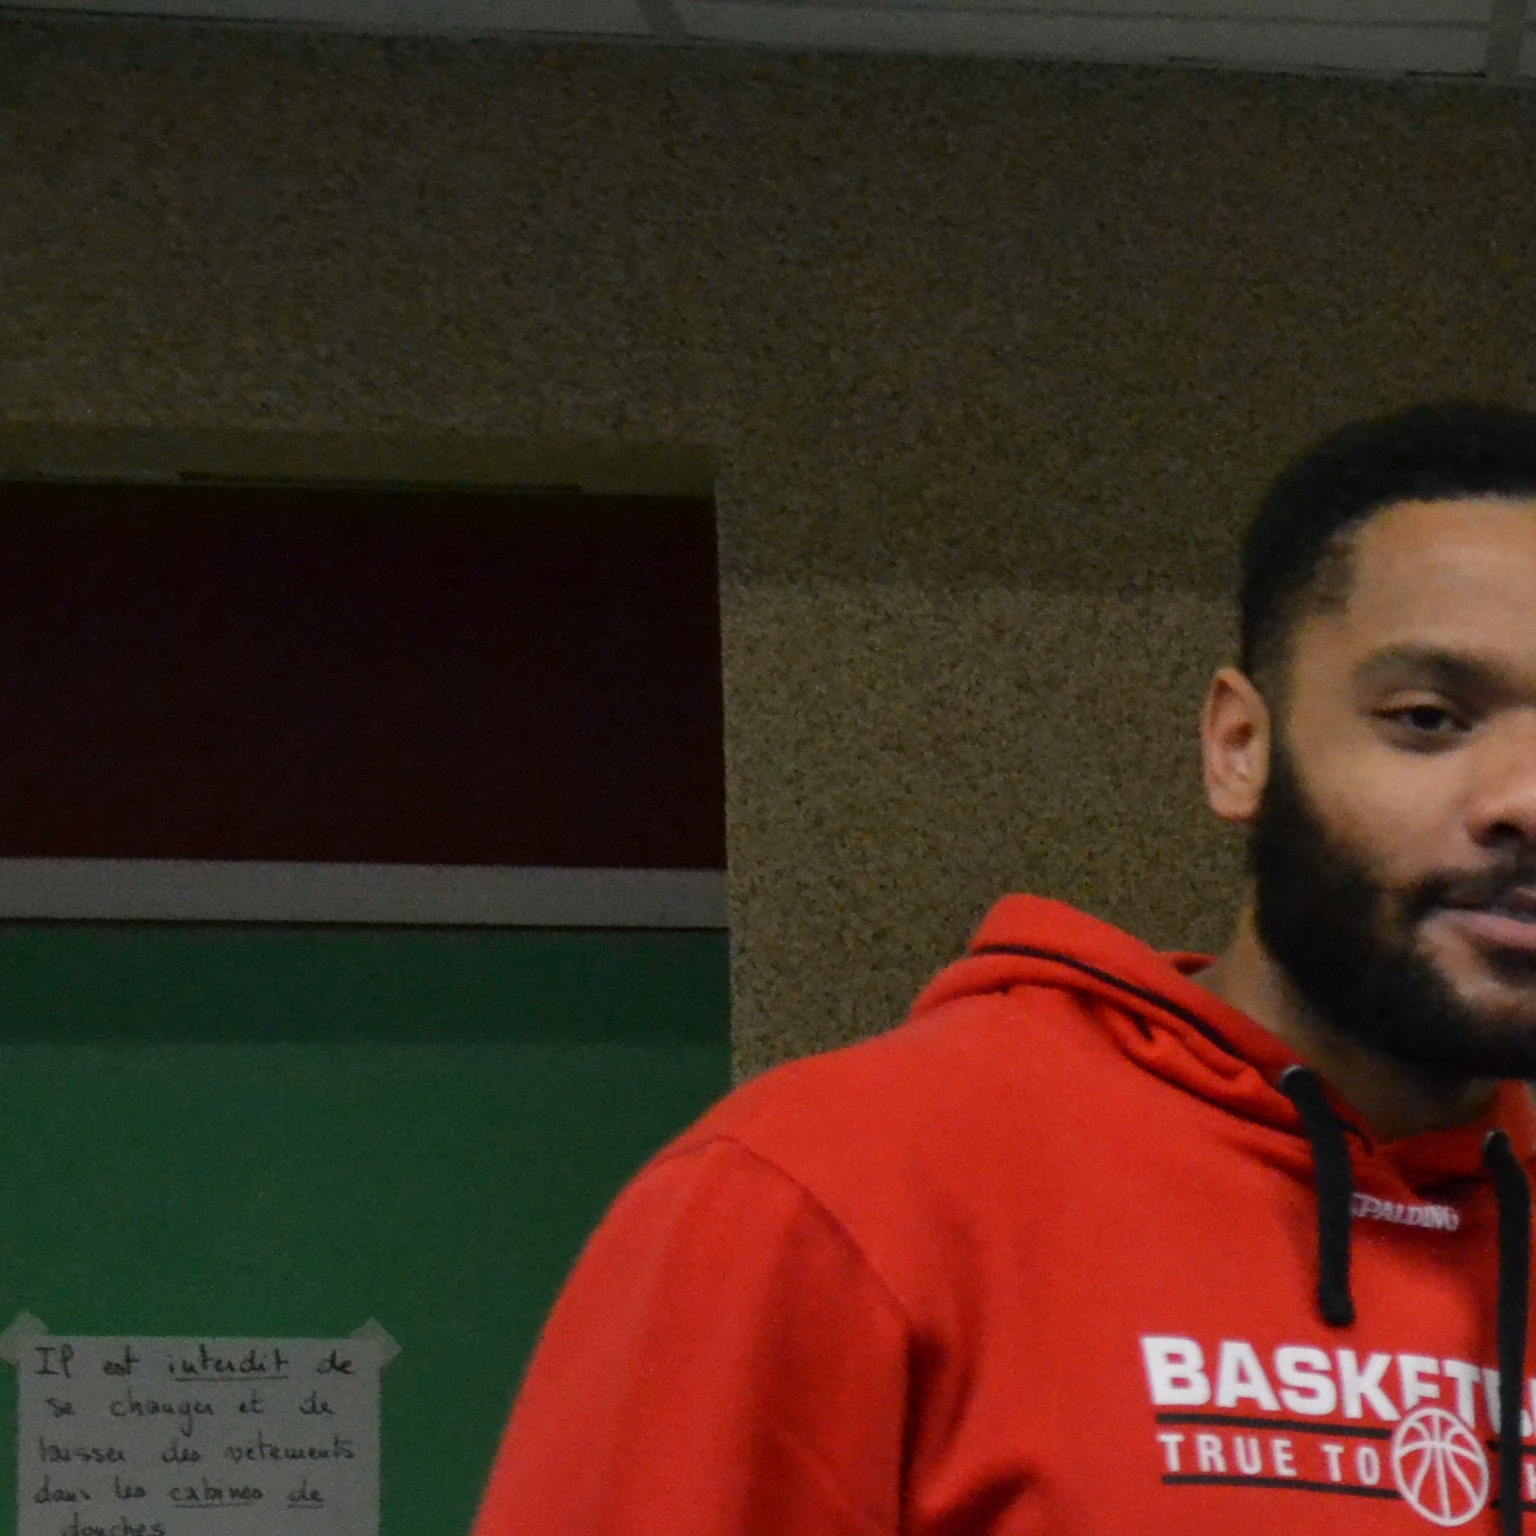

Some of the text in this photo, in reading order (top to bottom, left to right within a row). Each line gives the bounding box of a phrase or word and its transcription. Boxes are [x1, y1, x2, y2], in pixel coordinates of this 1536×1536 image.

[35, 1343, 355, 1379] Il est interdit de
[109, 1387, 215, 1437] changer
[239, 1389, 265, 1414] et
[299, 1390, 337, 1415] de
[38, 1436, 126, 1462] laisser
[162, 1438, 200, 1463] des
[1157, 1432, 1297, 1477] TRUE
[1322, 1442, 1381, 1486] TO
[115, 1476, 147, 1500] les
[287, 1479, 324, 1501] de
